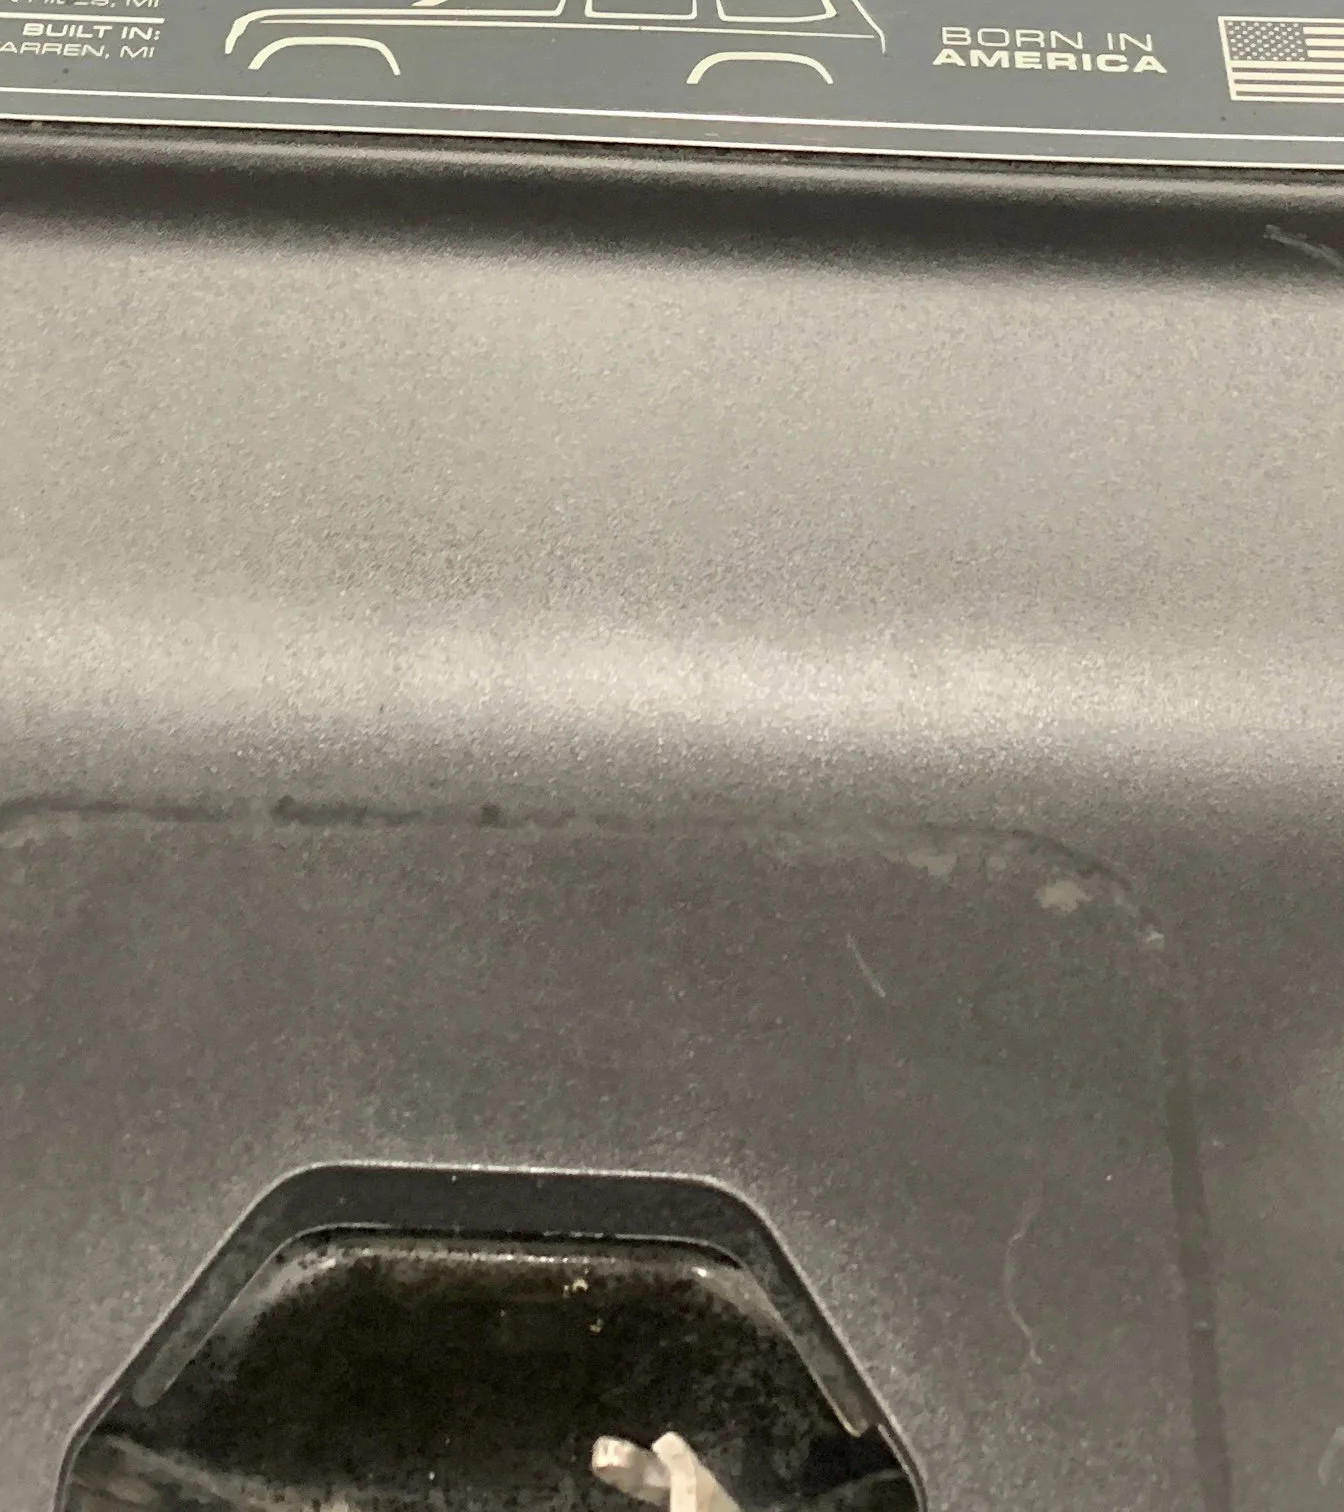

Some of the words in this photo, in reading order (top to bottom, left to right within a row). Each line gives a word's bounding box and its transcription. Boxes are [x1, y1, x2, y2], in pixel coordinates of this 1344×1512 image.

[21, 22, 114, 40] BUILT
[120, 26, 161, 42] IN:
[940, 26, 1084, 51] BORN
[1106, 32, 1154, 53] IN
[118, 45, 156, 60] MI
[931, 48, 1169, 75] AMERICA
